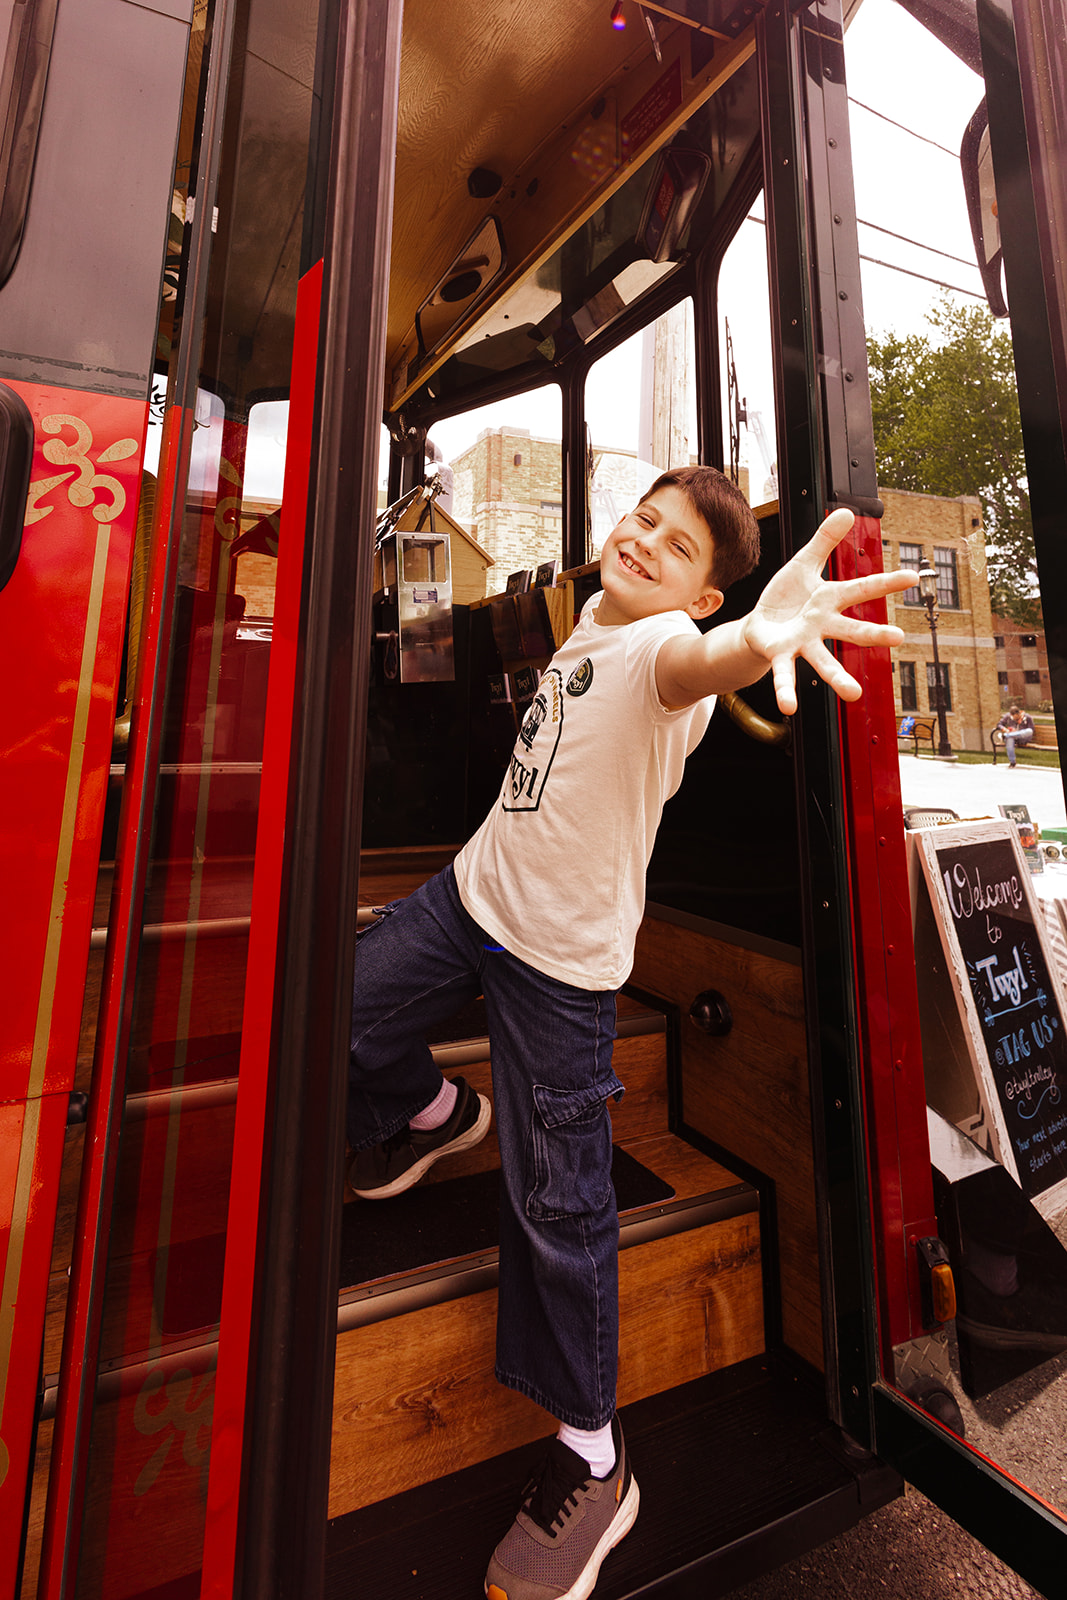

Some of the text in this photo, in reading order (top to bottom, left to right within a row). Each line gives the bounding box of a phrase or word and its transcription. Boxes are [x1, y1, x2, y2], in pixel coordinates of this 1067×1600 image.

[943, 863, 1023, 919] Welcome
[986, 914, 1003, 944] to
[975, 945, 1029, 1006] Twyl
[1031, 1014, 1054, 1049] US
